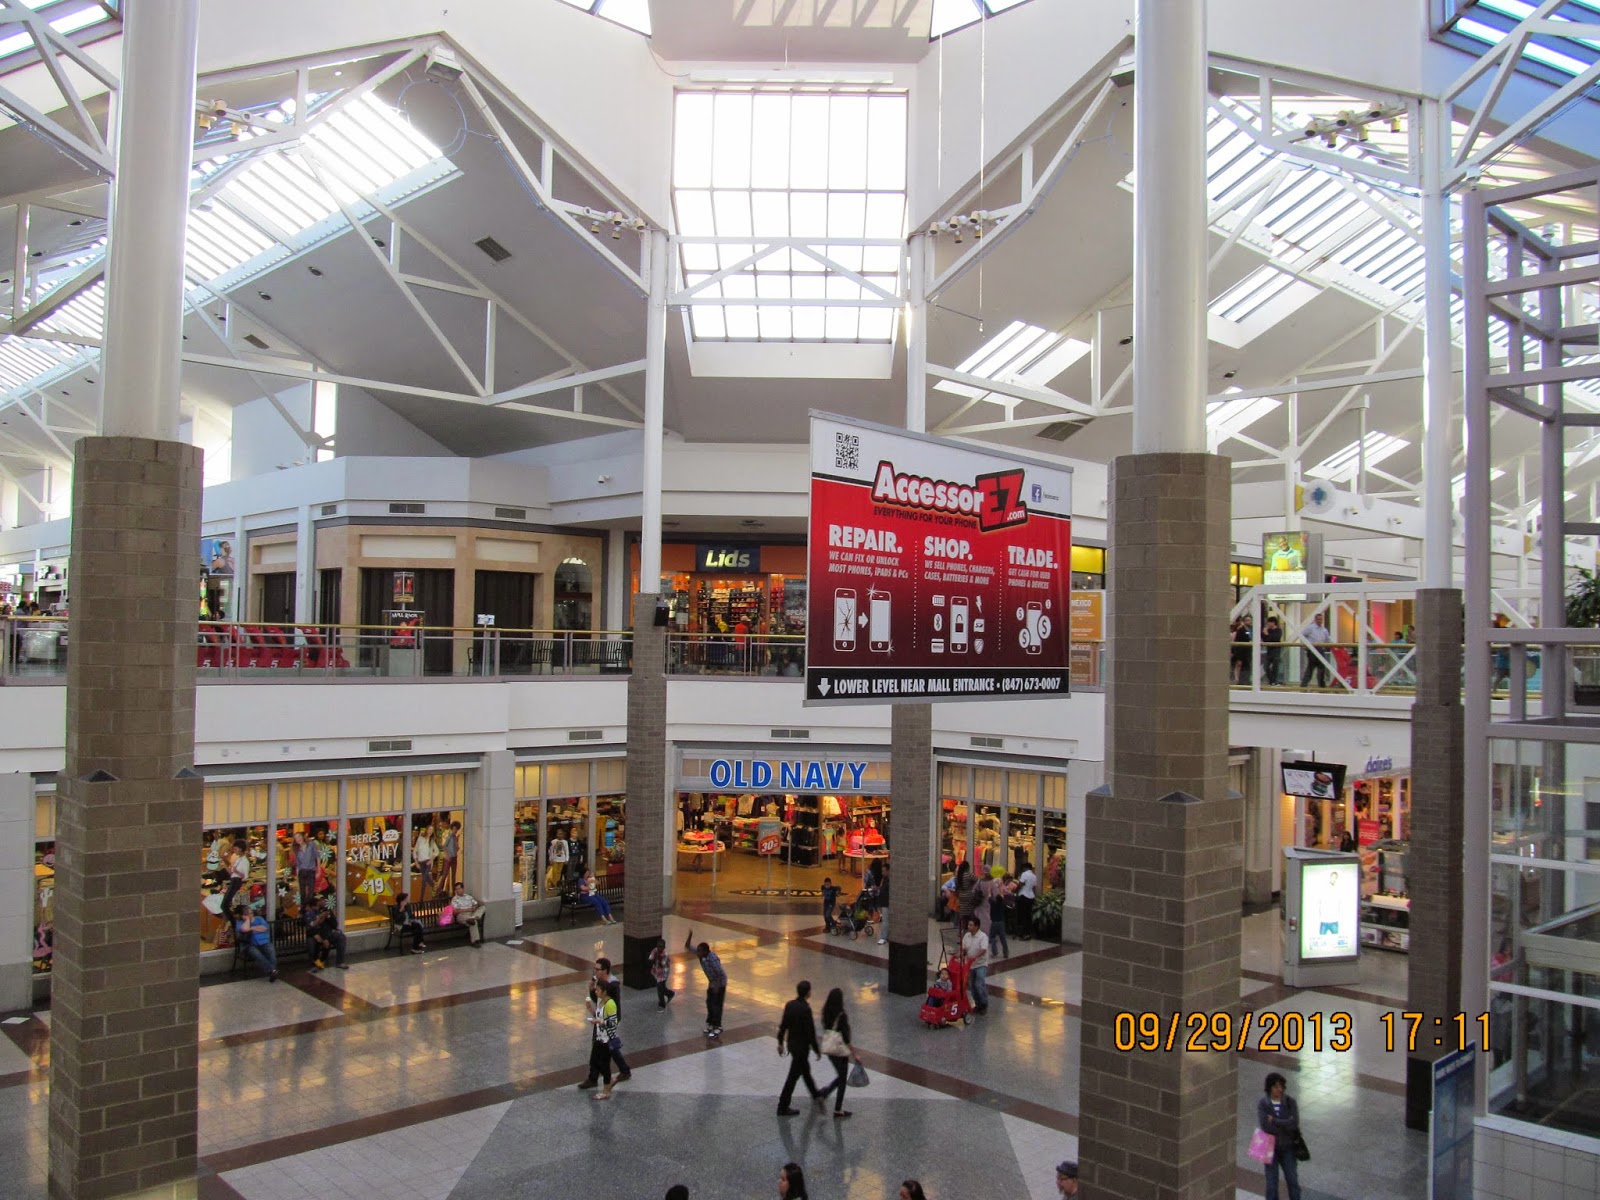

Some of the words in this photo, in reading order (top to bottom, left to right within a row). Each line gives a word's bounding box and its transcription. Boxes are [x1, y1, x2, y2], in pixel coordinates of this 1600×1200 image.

[874, 506, 918, 521] EVERYTHING
[919, 513, 933, 524] FOR
[935, 515, 954, 526] YOUR
[954, 518, 978, 529] PHONE
[828, 524, 904, 554] REPAIR.
[924, 535, 974, 561] SHOP.
[705, 550, 751, 568] Lids
[829, 551, 839, 561] WE
[841, 552, 854, 562] CAN
[855, 554, 865, 563] FIX
[866, 555, 875, 564] OR
[876, 556, 900, 567] UNLOCK
[1007, 545, 1059, 570] TRADE.
[829, 563, 847, 574] MOST
[848, 565, 873, 577] PHONES,
[874, 567, 892, 577] iPADS
[898, 569, 909, 579] PCs
[924, 560, 933, 569] WE
[934, 561, 946, 570] SELL
[946, 562, 968, 573] PHONES,
[969, 565, 996, 576] CHARGERS,
[1008, 568, 1017, 577] GET
[1018, 569, 1030, 578] CASH
[1030, 570, 1040, 578] FOR
[924, 571, 942, 582] CASES,
[943, 572, 969, 584] BATTERIES
[975, 576, 990, 586] MORE
[1008, 579, 1026, 588] PHONES
[1032, 581, 1050, 590] DEVICES
[202, 659, 211, 669] 5
[248, 659, 257, 669] 5
[271, 659, 279, 669] 5
[292, 659, 301, 669] 5
[834, 679, 869, 695] LOWER
[871, 679, 900, 693] LEVEL
[900, 679, 926, 693] NEAR
[927, 679, 951, 693] MALL
[953, 678, 995, 692] ENTRANCE
[1001, 677, 1024, 692] (847)
[1024, 677, 1061, 691] 673-0007
[709, 758, 773, 788] OLD
[779, 761, 868, 790] NAVY
[351, 843, 400, 863] SKINNY
[363, 877, 384, 895] $19
[950, 1003, 959, 1016] 5
